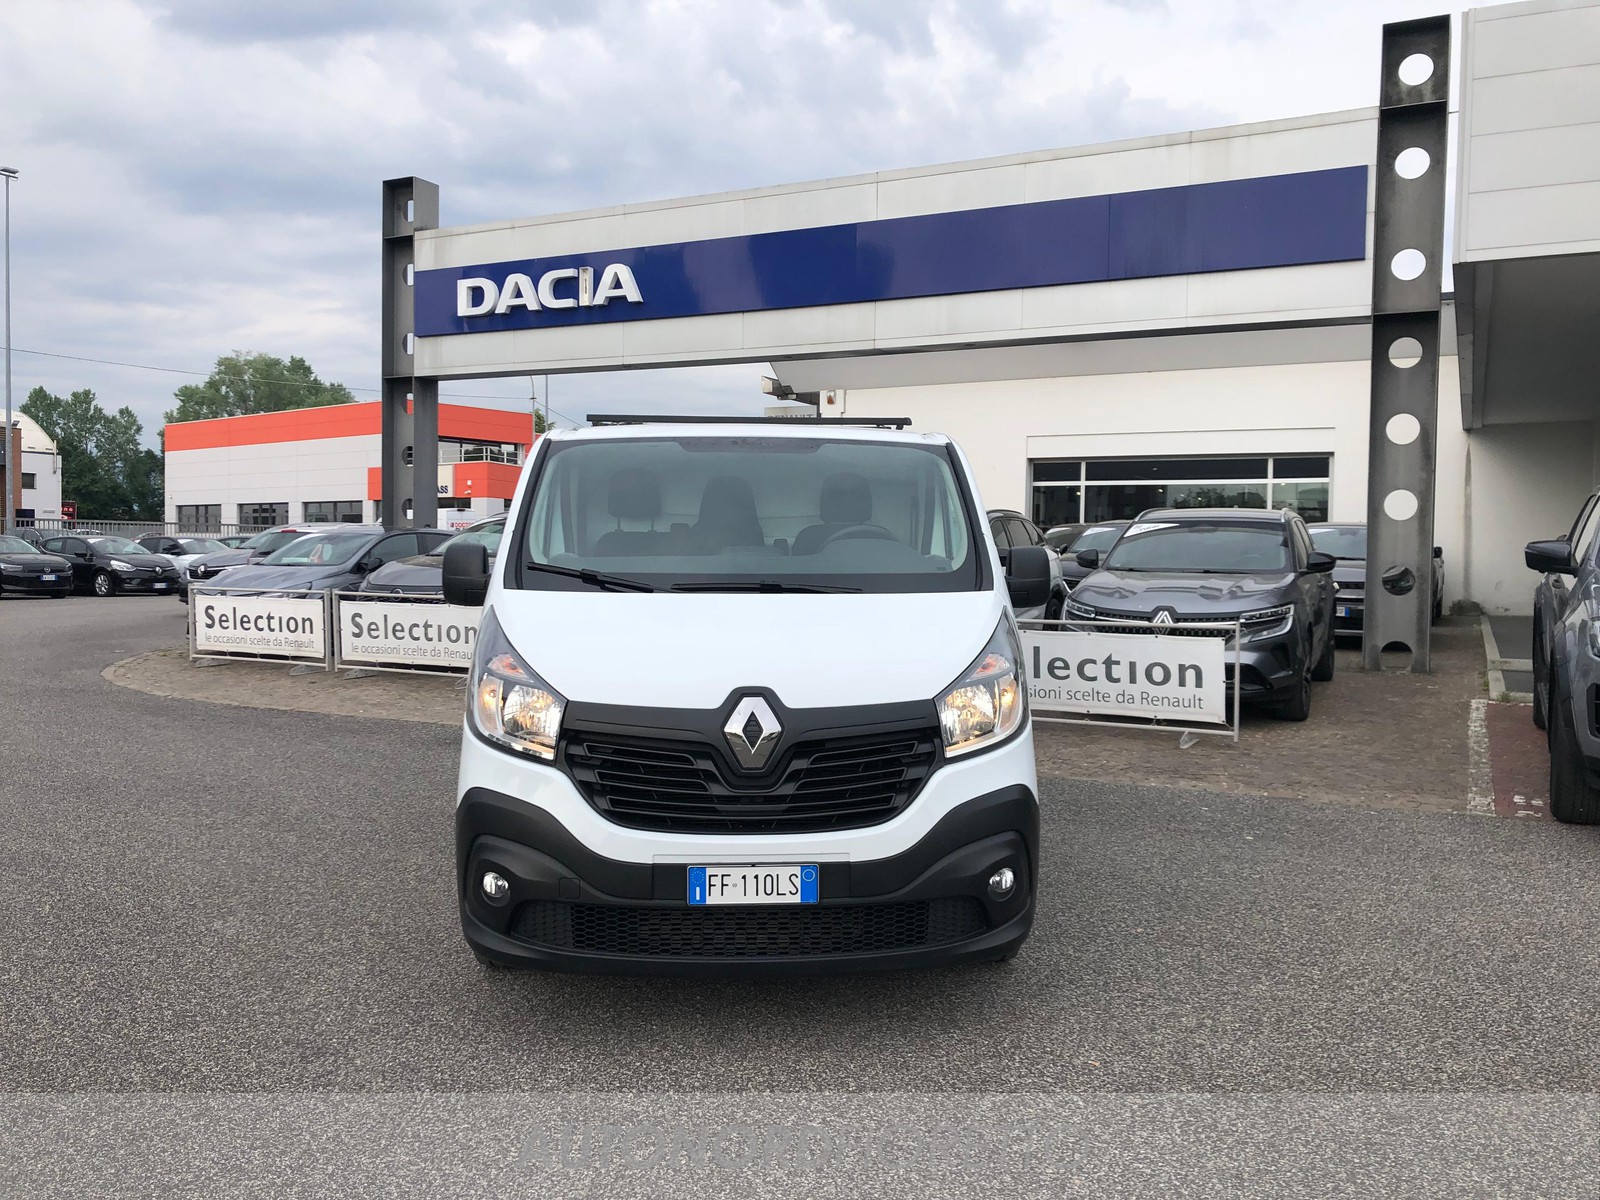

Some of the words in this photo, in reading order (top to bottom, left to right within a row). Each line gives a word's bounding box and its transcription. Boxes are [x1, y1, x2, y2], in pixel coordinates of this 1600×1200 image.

[457, 263, 644, 316] DACIA
[204, 605, 314, 634] Selection
[351, 612, 478, 644] Selection
[205, 632, 212, 643] le
[214, 634, 248, 645] occasioni
[250, 636, 271, 646] scelte
[273, 636, 282, 647] da
[284, 637, 314, 648] Renault
[352, 642, 358, 653] le
[361, 644, 400, 656] occasioni
[402, 645, 428, 657] scelte
[430, 646, 441, 658] da
[1033, 646, 1204, 688] lection
[1066, 688, 1111, 704] scelte
[1116, 690, 1134, 704] da
[1140, 691, 1204, 710] Renault
